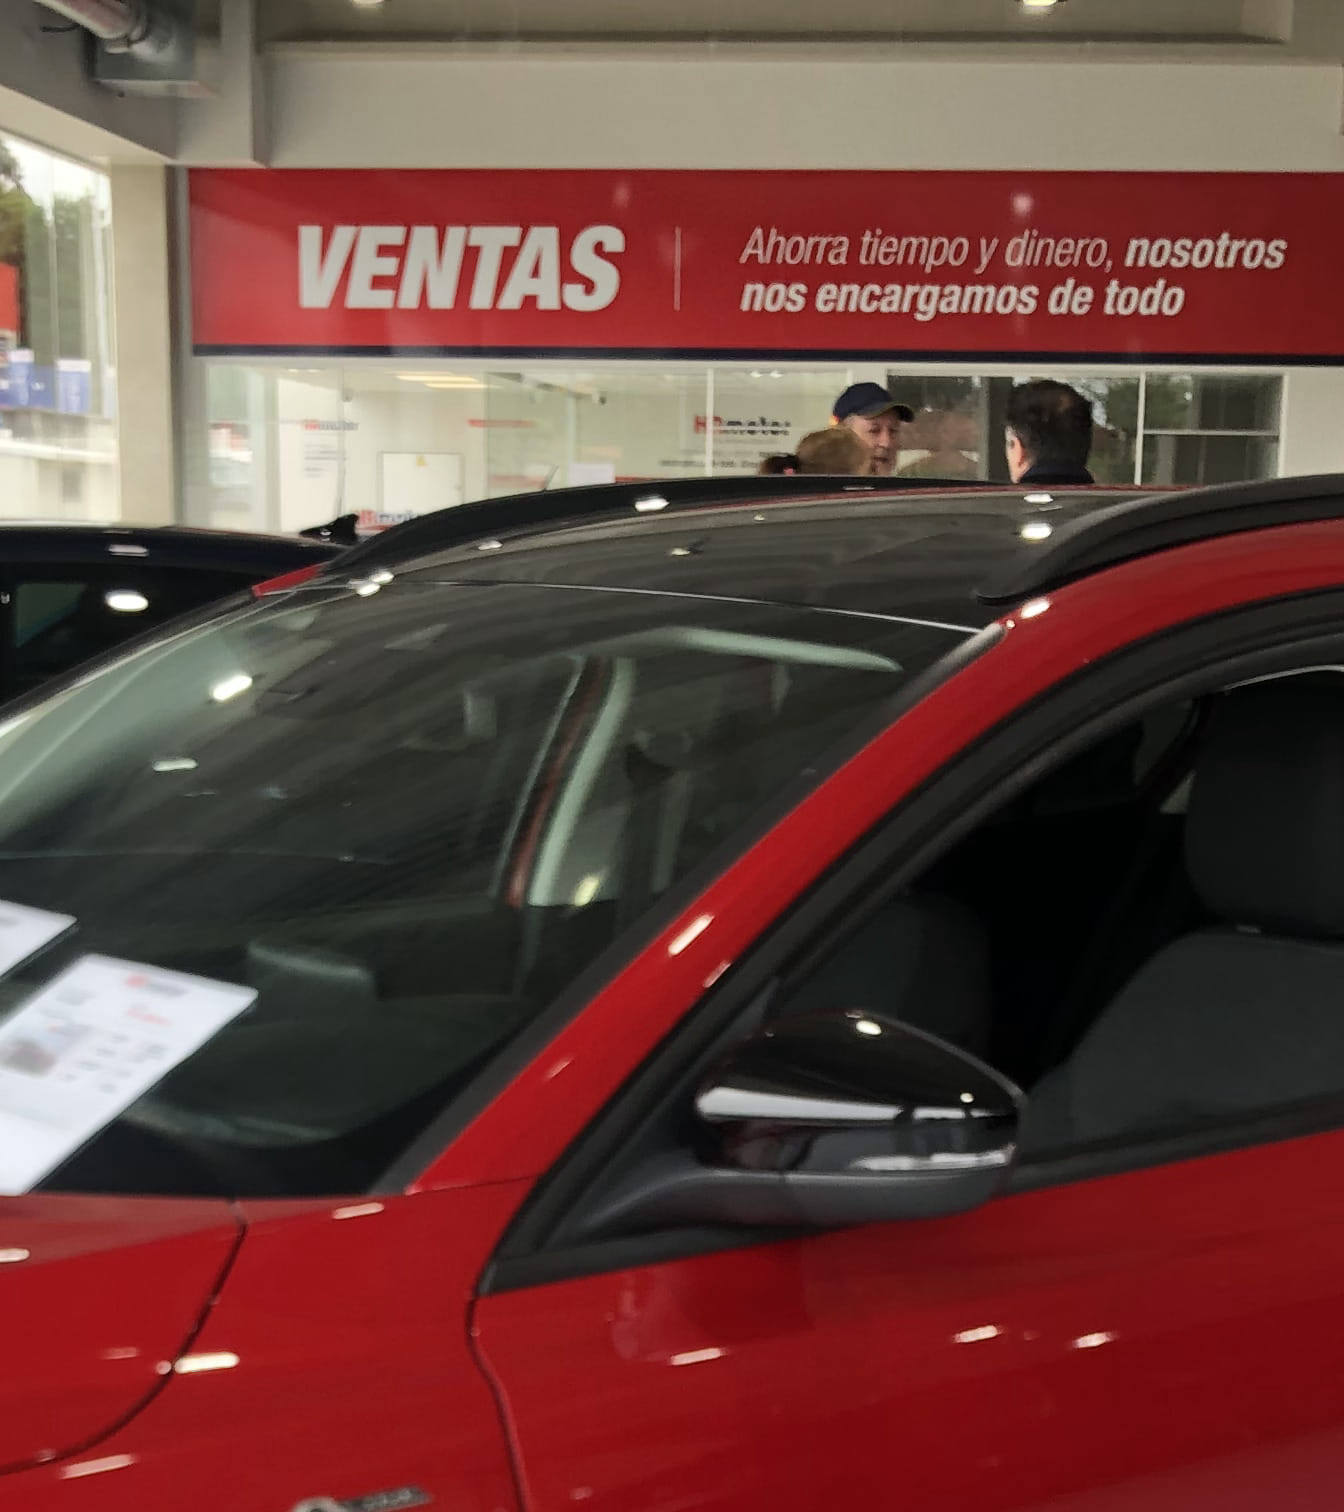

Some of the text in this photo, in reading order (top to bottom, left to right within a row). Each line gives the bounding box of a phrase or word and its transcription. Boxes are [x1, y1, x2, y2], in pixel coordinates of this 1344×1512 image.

[298, 225, 626, 312] VENTAS
[739, 226, 1288, 275] Ahorra tiempo y dinero, nosotros
[740, 277, 1185, 321] nos encargamos de todo
